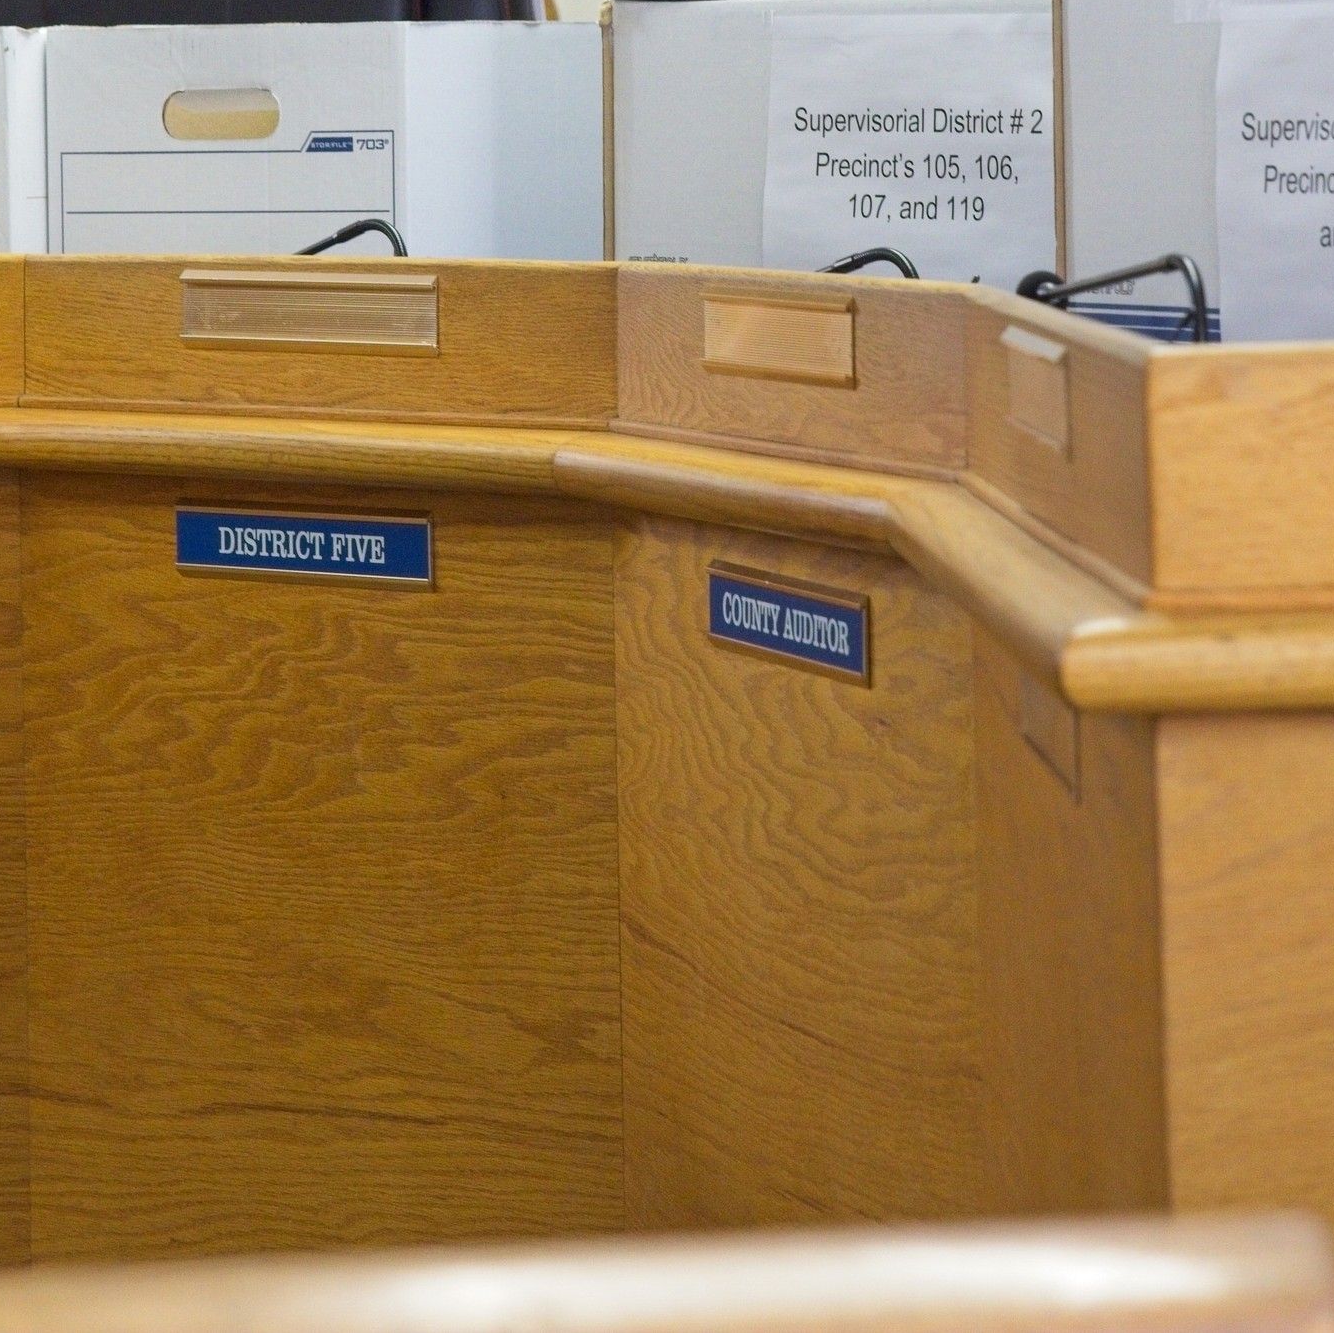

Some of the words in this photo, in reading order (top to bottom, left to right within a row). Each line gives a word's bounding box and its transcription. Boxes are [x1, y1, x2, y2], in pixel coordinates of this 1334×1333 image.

[794, 106, 925, 138] Supervisorial
[933, 107, 1004, 134] District
[1009, 108, 1024, 135] #
[1030, 108, 1043, 135] 2
[815, 151, 915, 179] Precinct's
[923, 153, 966, 184] 105,
[975, 154, 1019, 184] 106,
[849, 193, 891, 223] 107,
[899, 194, 938, 221] and
[947, 195, 985, 222] 119
[218, 526, 326, 561] DISTRICT
[329, 532, 386, 565] FIVE
[722, 592, 780, 639] COUNTY
[783, 605, 849, 657] AUDITOR
